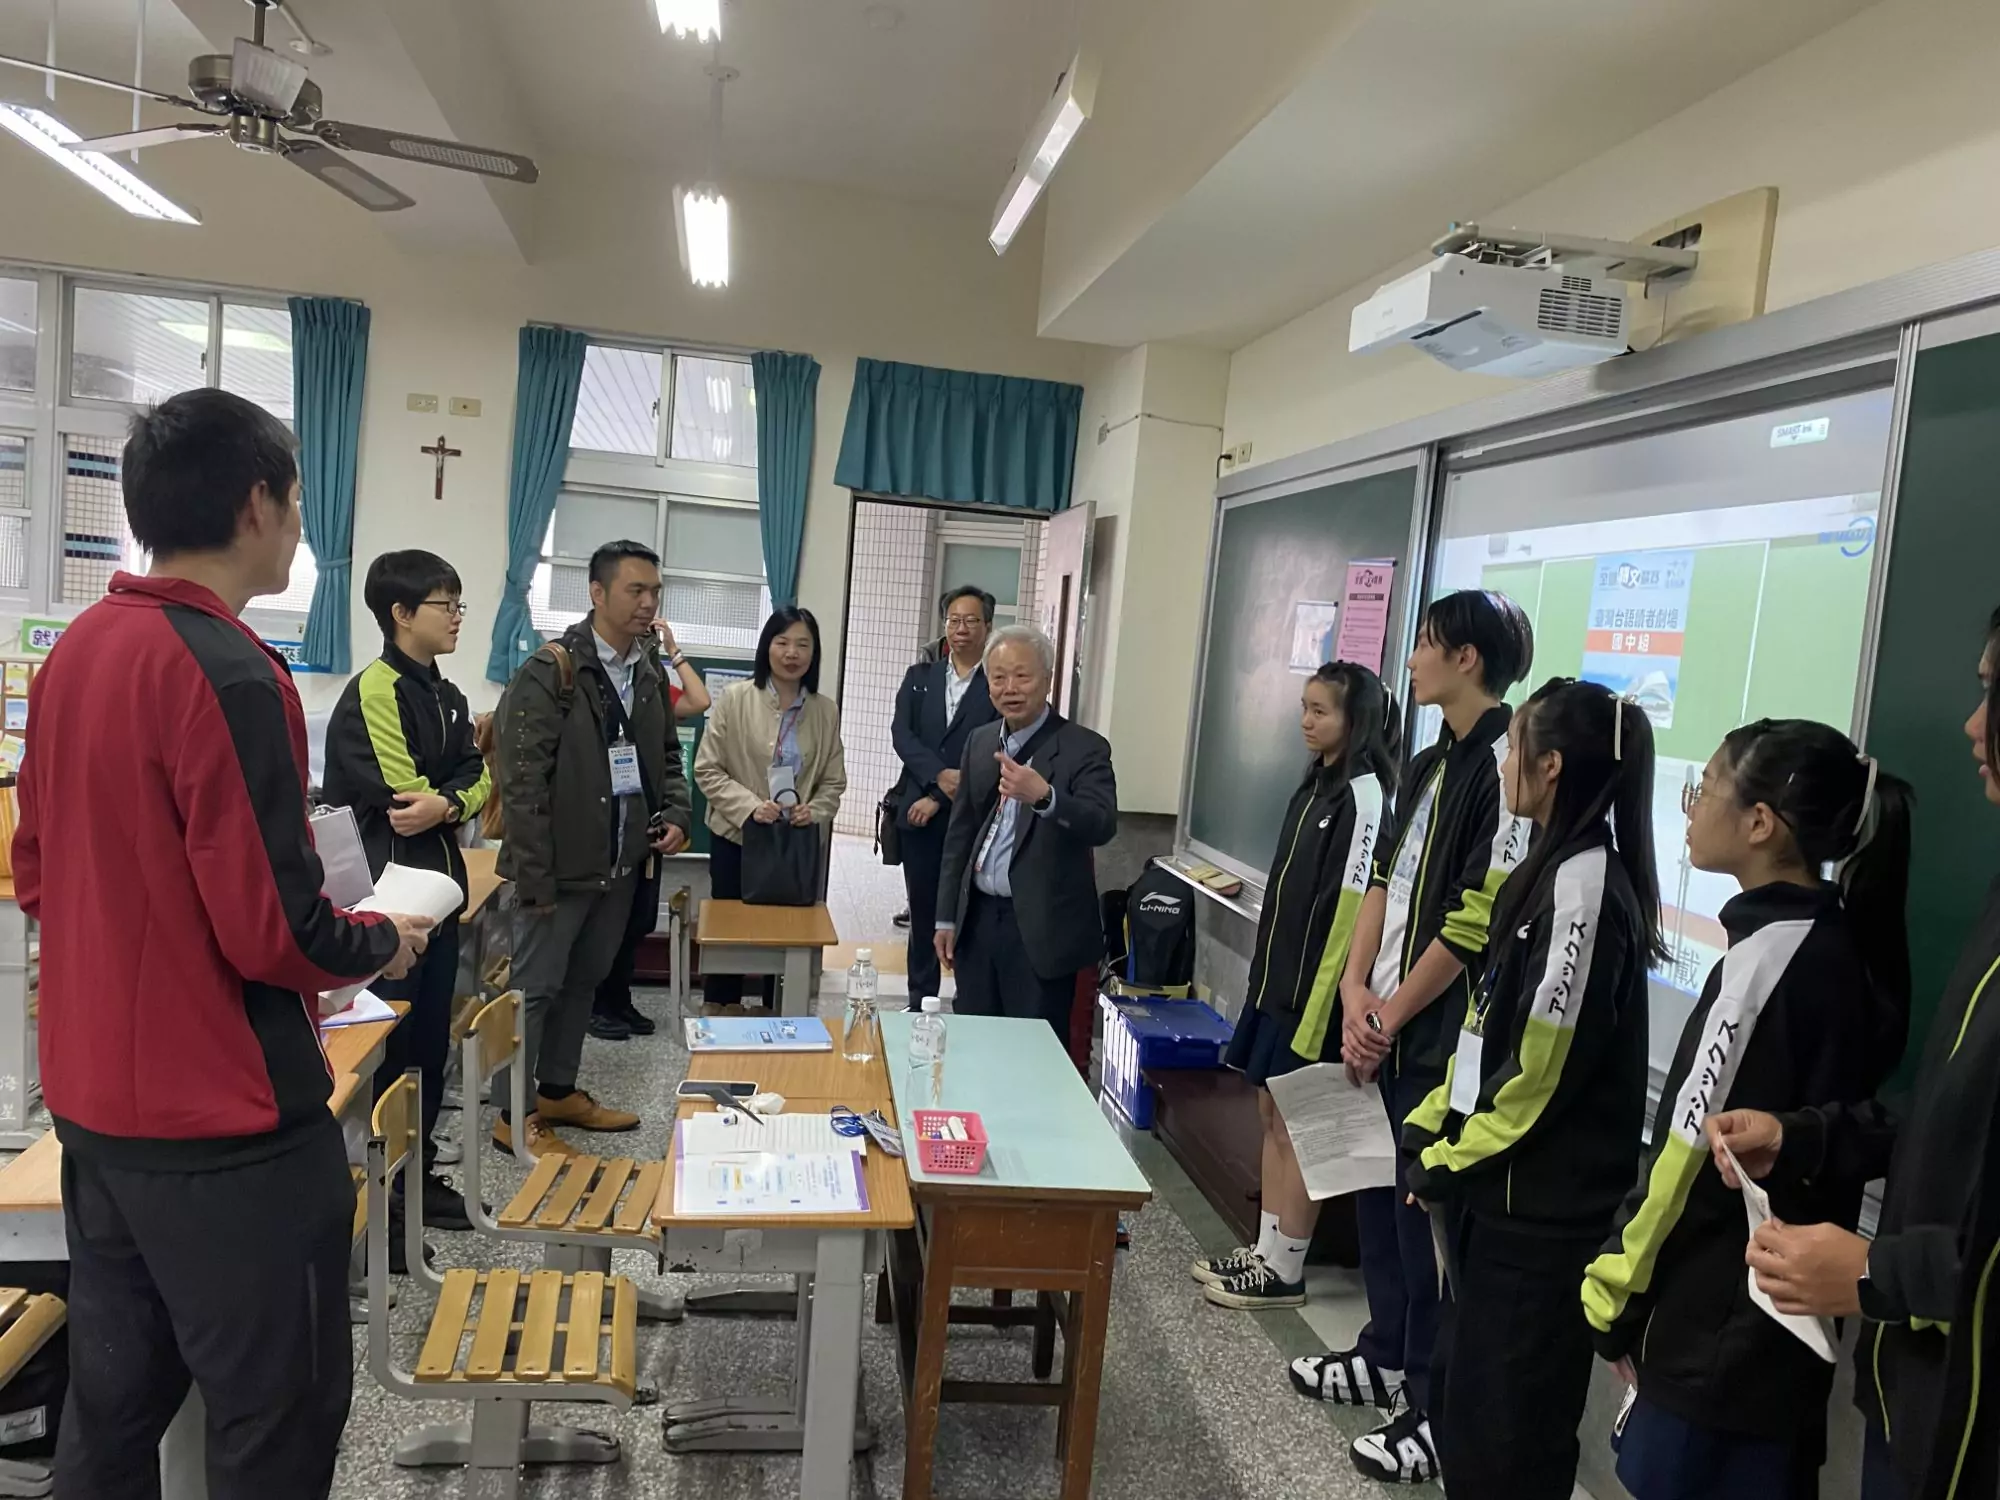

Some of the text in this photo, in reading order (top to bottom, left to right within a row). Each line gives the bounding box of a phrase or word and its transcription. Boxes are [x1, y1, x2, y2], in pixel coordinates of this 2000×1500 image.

[1612, 632, 1650, 652] 國中組
[1139, 903, 1181, 914] LI-NING
[1548, 921, 1587, 1016] アシックス
[1684, 1019, 1739, 1135] アシックス
